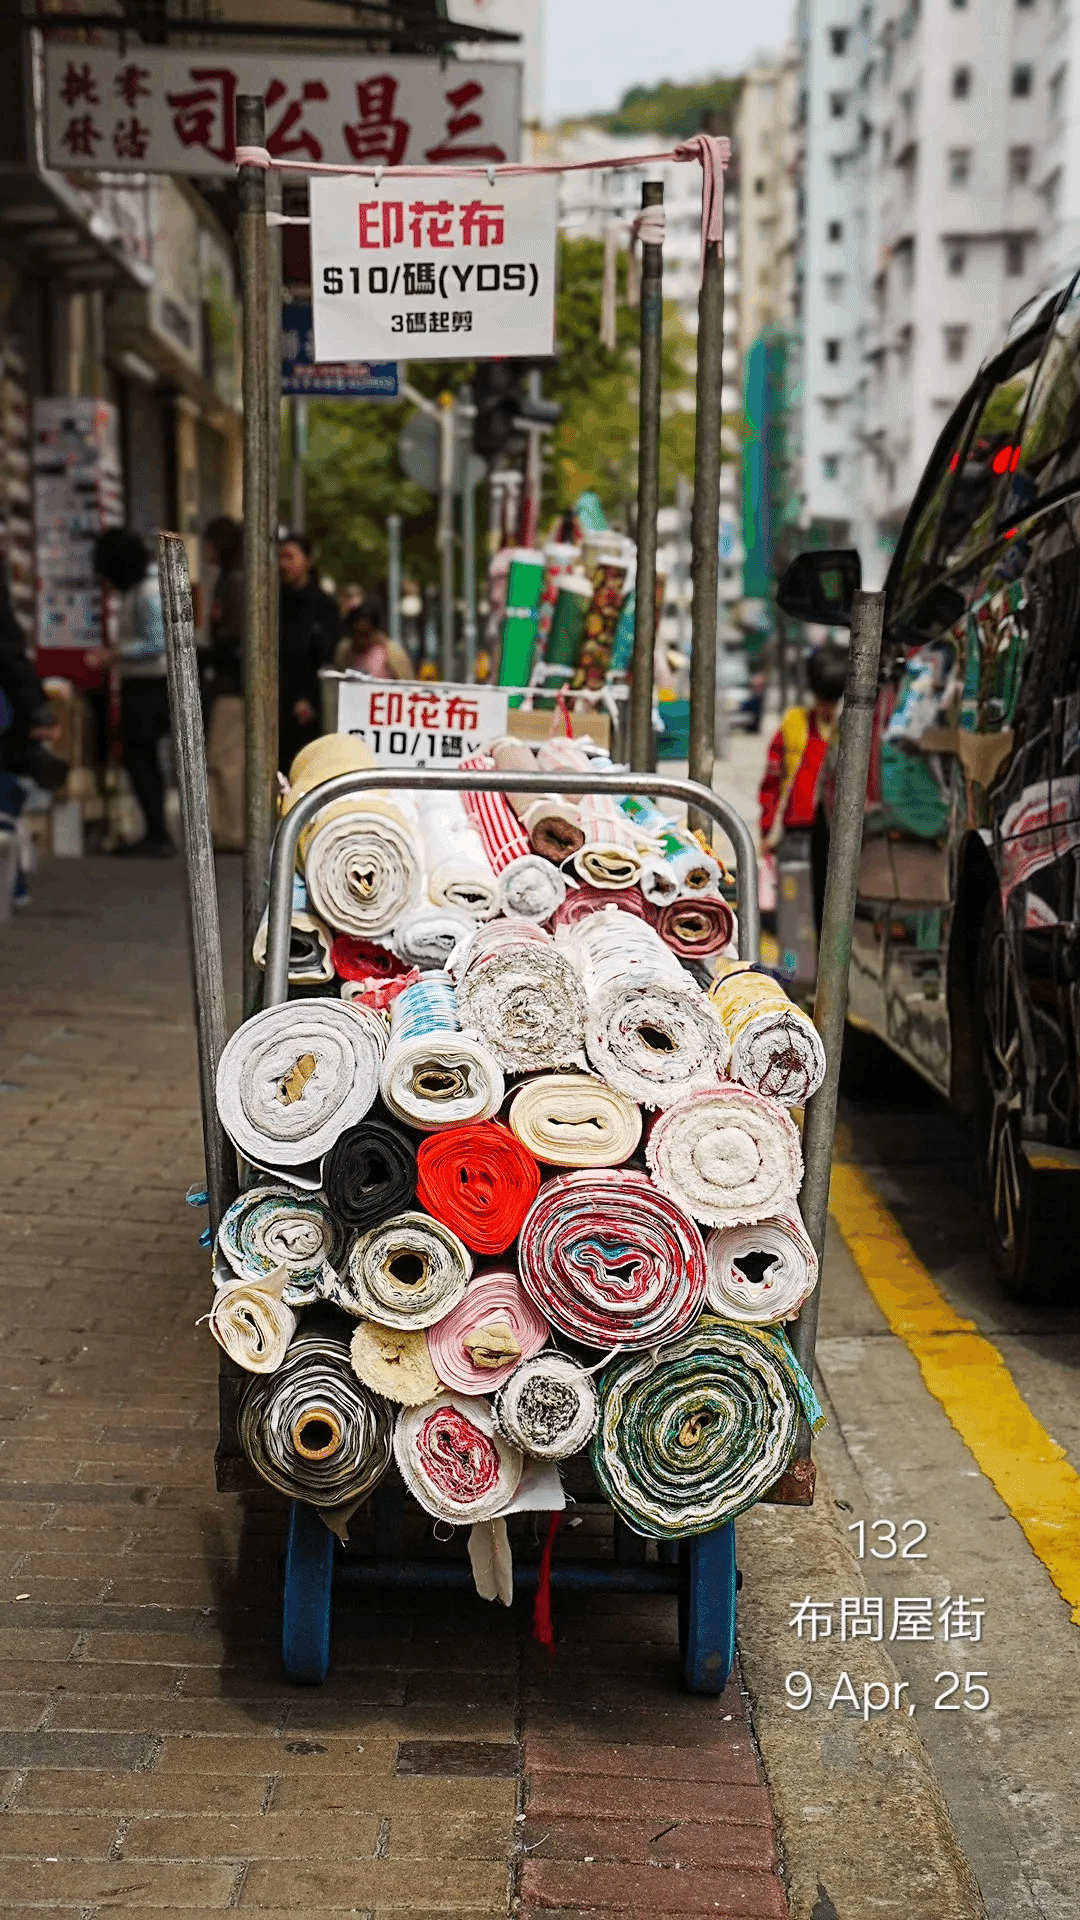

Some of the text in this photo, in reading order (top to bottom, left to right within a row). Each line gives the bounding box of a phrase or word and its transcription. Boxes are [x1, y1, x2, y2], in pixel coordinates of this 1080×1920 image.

[358, 200, 505, 249] 印花布
[390, 310, 473, 334] 3碼起剪
[369, 691, 479, 731] 印花布
